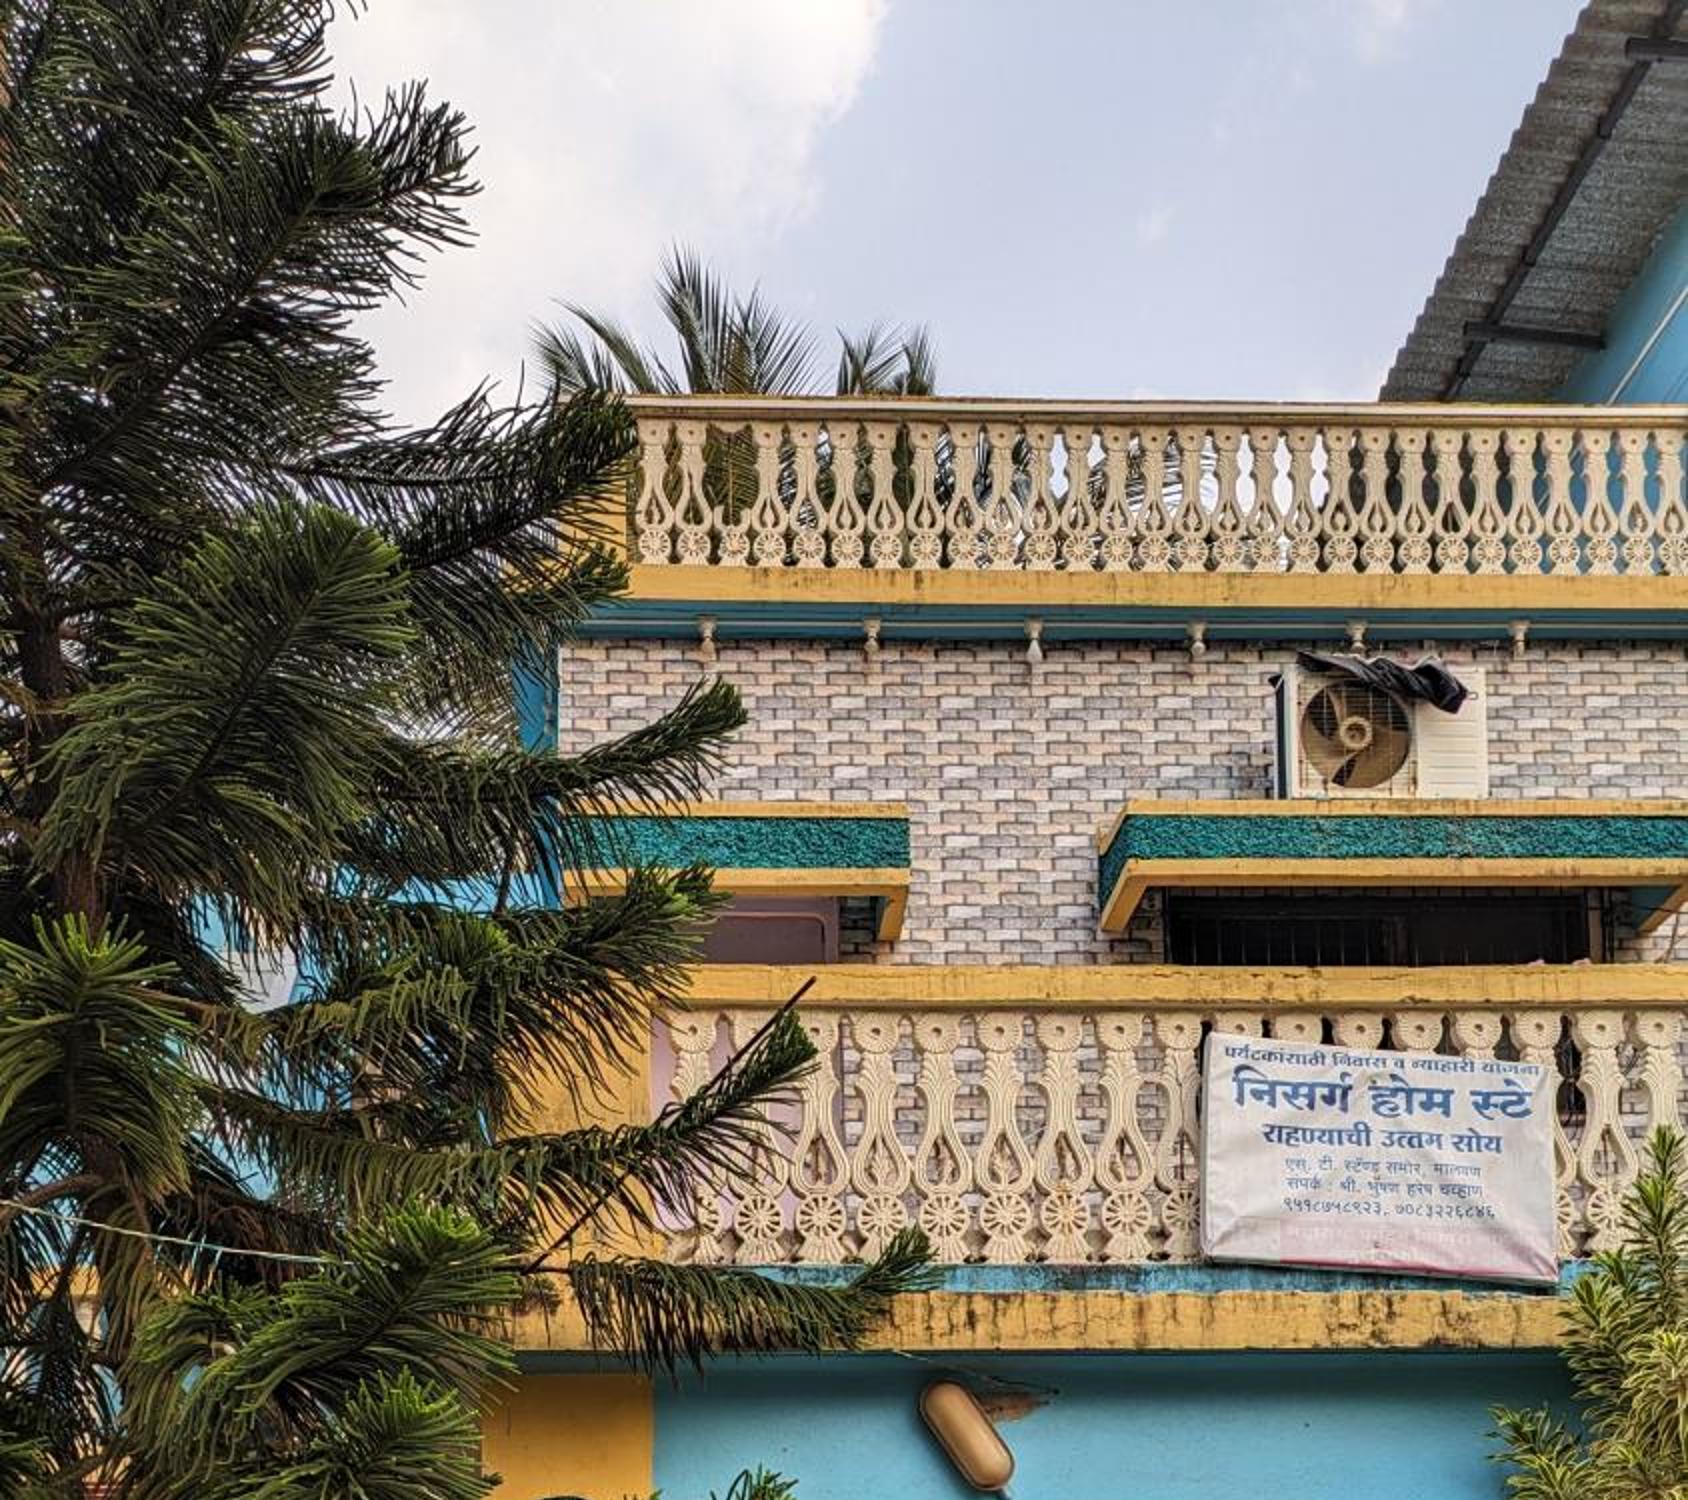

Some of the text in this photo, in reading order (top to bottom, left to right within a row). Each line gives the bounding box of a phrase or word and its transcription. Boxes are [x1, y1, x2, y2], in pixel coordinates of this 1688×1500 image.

[1225, 1044, 1326, 1066] पर्यटकांसाठी
[1333, 1051, 1386, 1068] निवास
[1232, 1064, 1533, 1120] निसर्ग होम स्टे
[1262, 1121, 1503, 1154] राहण्याची उत्तम सोय
